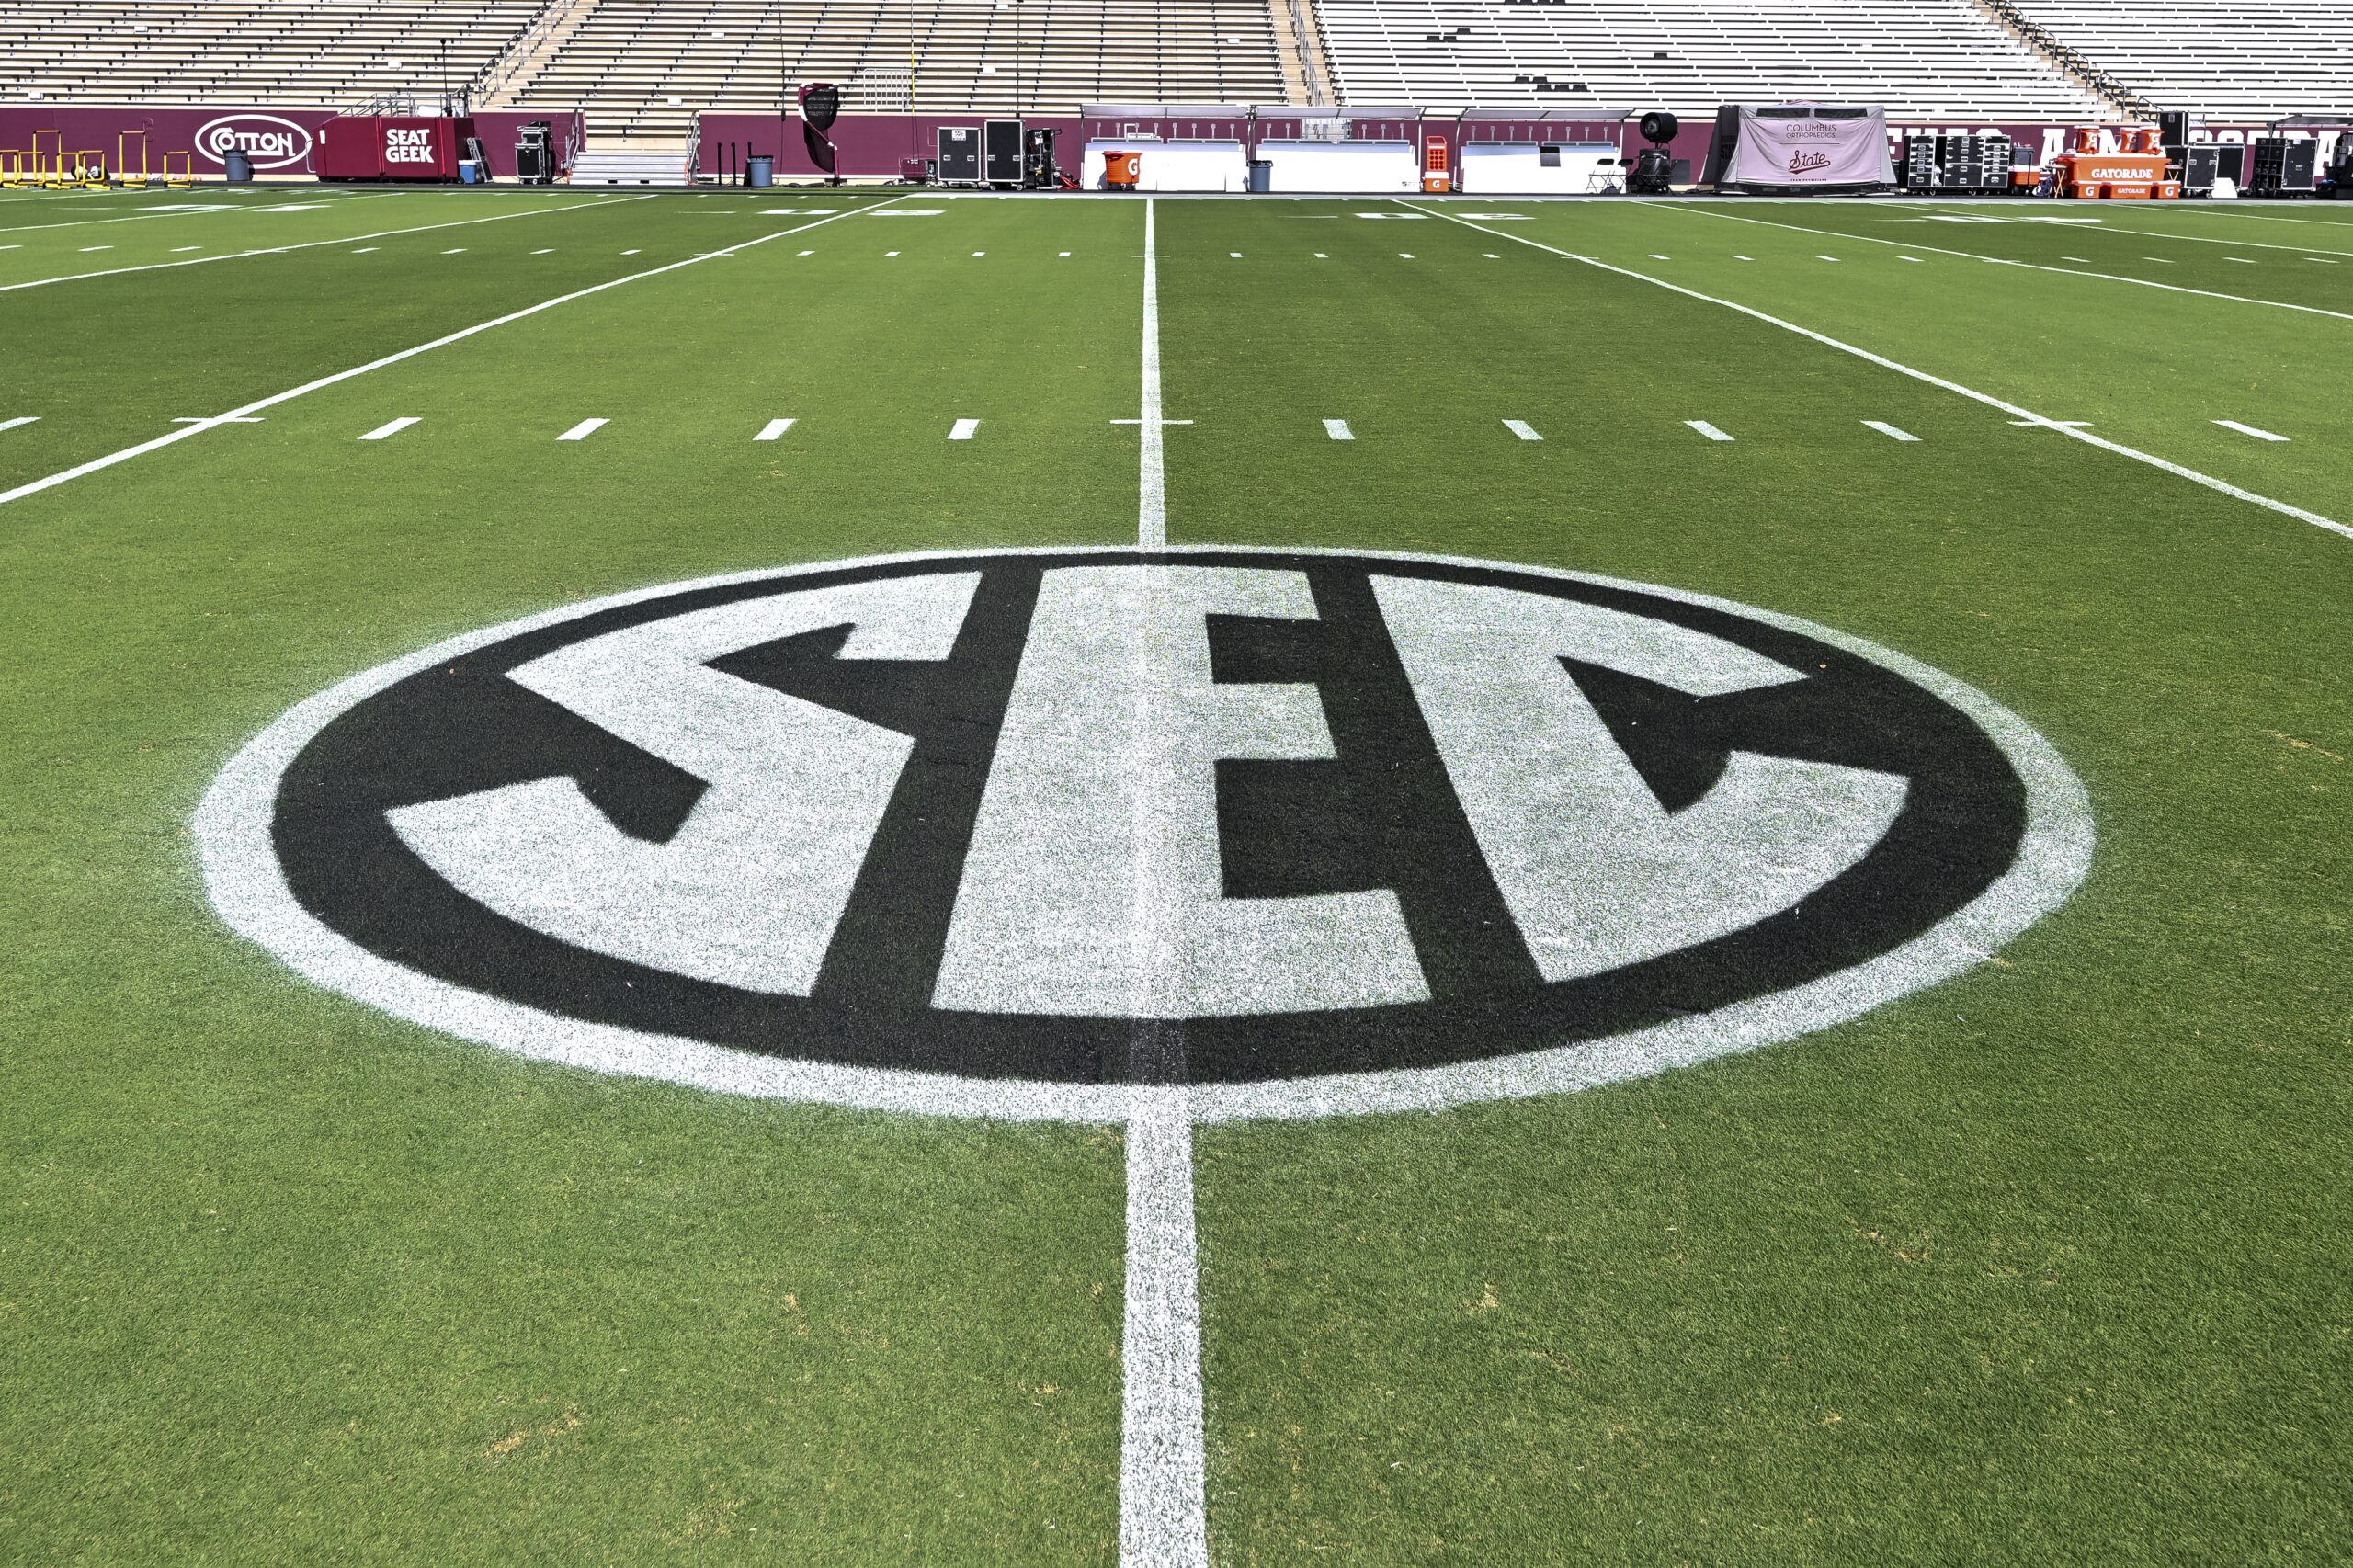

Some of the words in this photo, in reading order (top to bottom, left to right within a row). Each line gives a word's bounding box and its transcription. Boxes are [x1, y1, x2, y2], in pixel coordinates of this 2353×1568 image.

[1786, 124, 1836, 132] COLUMBUS
[210, 127, 296, 156] COTTON
[386, 129, 430, 145] SEAT
[385, 145, 435, 164] GEEK
[1789, 150, 1831, 174] State
[1128, 158, 1139, 176] G
[2091, 168, 2153, 178] GATORADE
[1432, 180, 1440, 188] G
[2085, 186, 2095, 197] G
[2165, 186, 2175, 197] G
[382, 563, 1913, 1017] SEC
